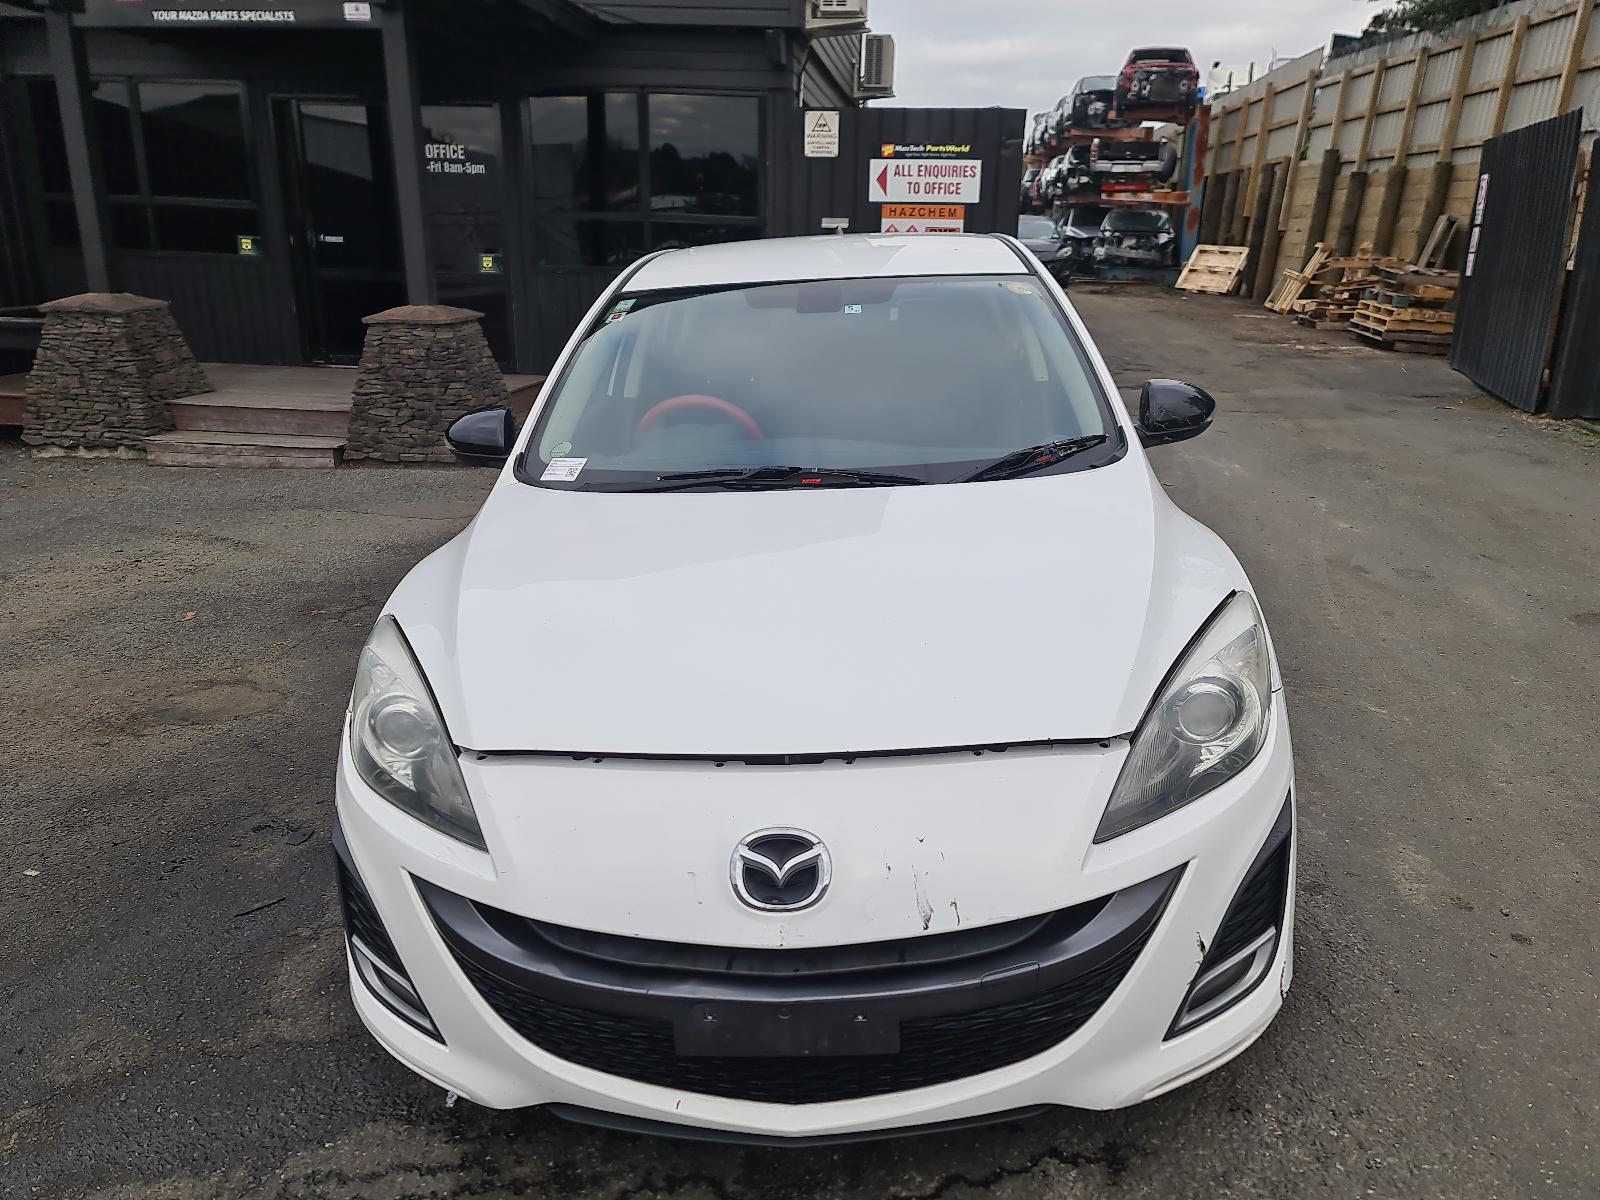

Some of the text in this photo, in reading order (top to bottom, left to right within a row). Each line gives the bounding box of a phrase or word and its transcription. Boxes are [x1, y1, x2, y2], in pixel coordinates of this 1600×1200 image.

[152, 10, 295, 21] YOUR MAZDA PARTS SPECIALISTS
[425, 144, 466, 159] OFFICE
[926, 144, 971, 153] PartsWorld
[443, 162, 486, 174] 8am-5pm
[893, 164, 978, 179] ALL ENQUIRIES
[907, 181, 963, 195] TO OFFICE
[889, 207, 958, 218] HAZCHEM
